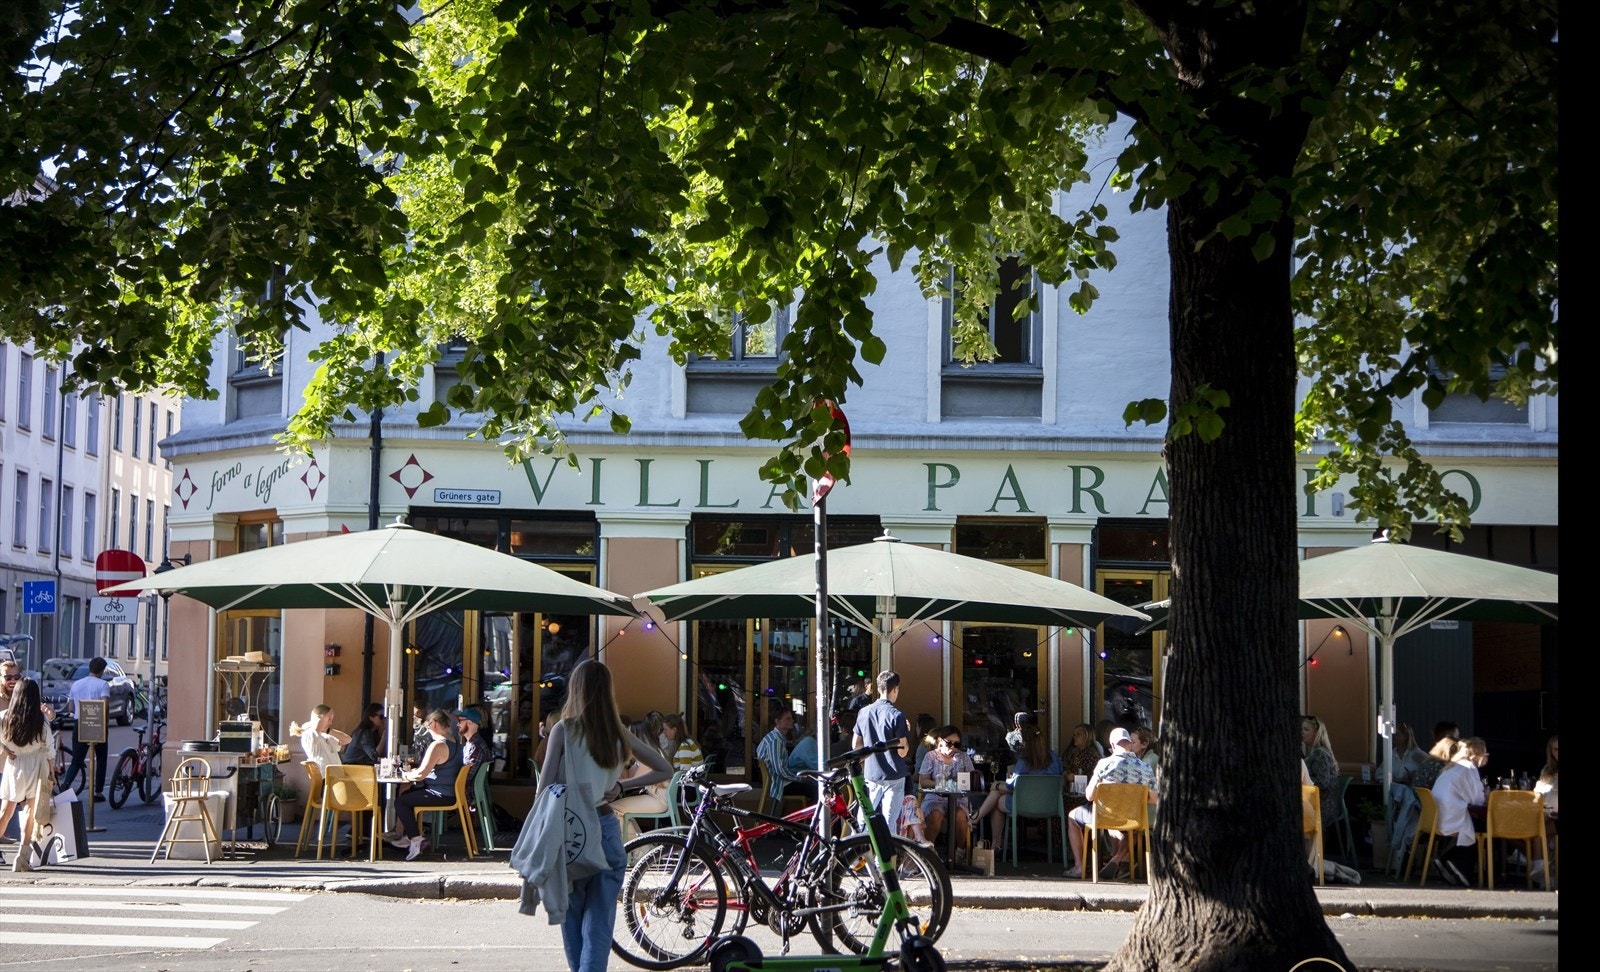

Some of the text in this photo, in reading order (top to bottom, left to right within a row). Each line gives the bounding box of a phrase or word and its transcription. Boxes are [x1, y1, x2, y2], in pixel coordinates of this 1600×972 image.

[206, 458, 290, 511] forno a legna
[439, 491, 495, 503] Grüners gate
[922, 462, 1482, 522] PARAIO
